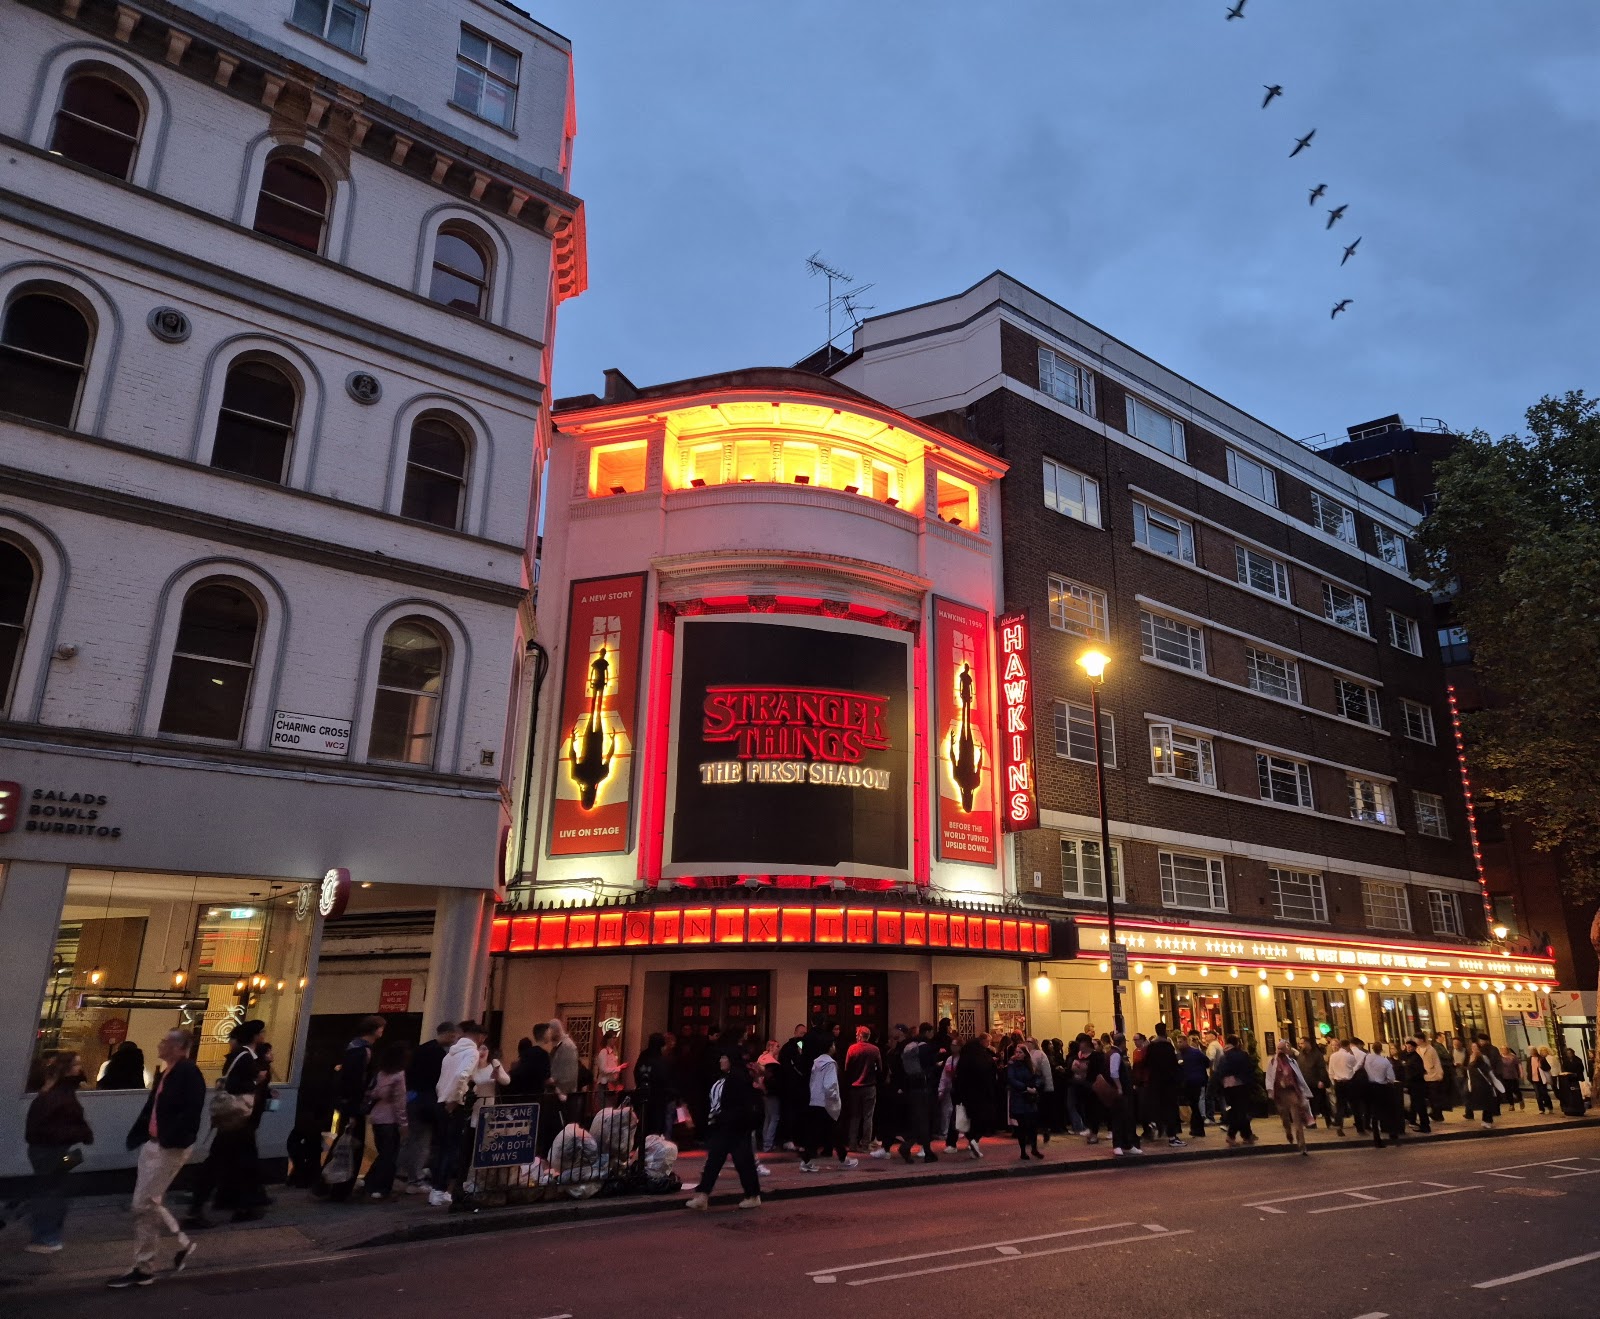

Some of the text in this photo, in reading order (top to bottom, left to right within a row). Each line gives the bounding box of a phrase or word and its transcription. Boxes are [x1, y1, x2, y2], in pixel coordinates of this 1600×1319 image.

[589, 594, 607, 602] NEW
[608, 590, 633, 600] STORY
[938, 609, 968, 625] HAWKINS,
[702, 692, 891, 742] STRANGER
[1003, 624, 1029, 821] HAWKINS
[276, 720, 349, 738] CHARING CROSS
[274, 732, 300, 744] ROAD
[325, 740, 345, 749] WC2
[736, 726, 866, 763] THINGS
[700, 761, 891, 790] THE FIRST SHADOW
[33, 788, 107, 805] SALADS
[29, 804, 98, 820] BOWLS
[26, 820, 121, 837] BURRITOS
[559, 826, 620, 838] LIVE ON STAGE
[948, 821, 982, 833] BEFORE THE
[943, 830, 989, 844] WORLD TURNED
[945, 840, 967, 850] UPSIDE
[576, 916, 981, 943] PHOENIX THEATRE
[506, 1141, 532, 1150] BOTH
[491, 1152, 518, 1161] WAYS
